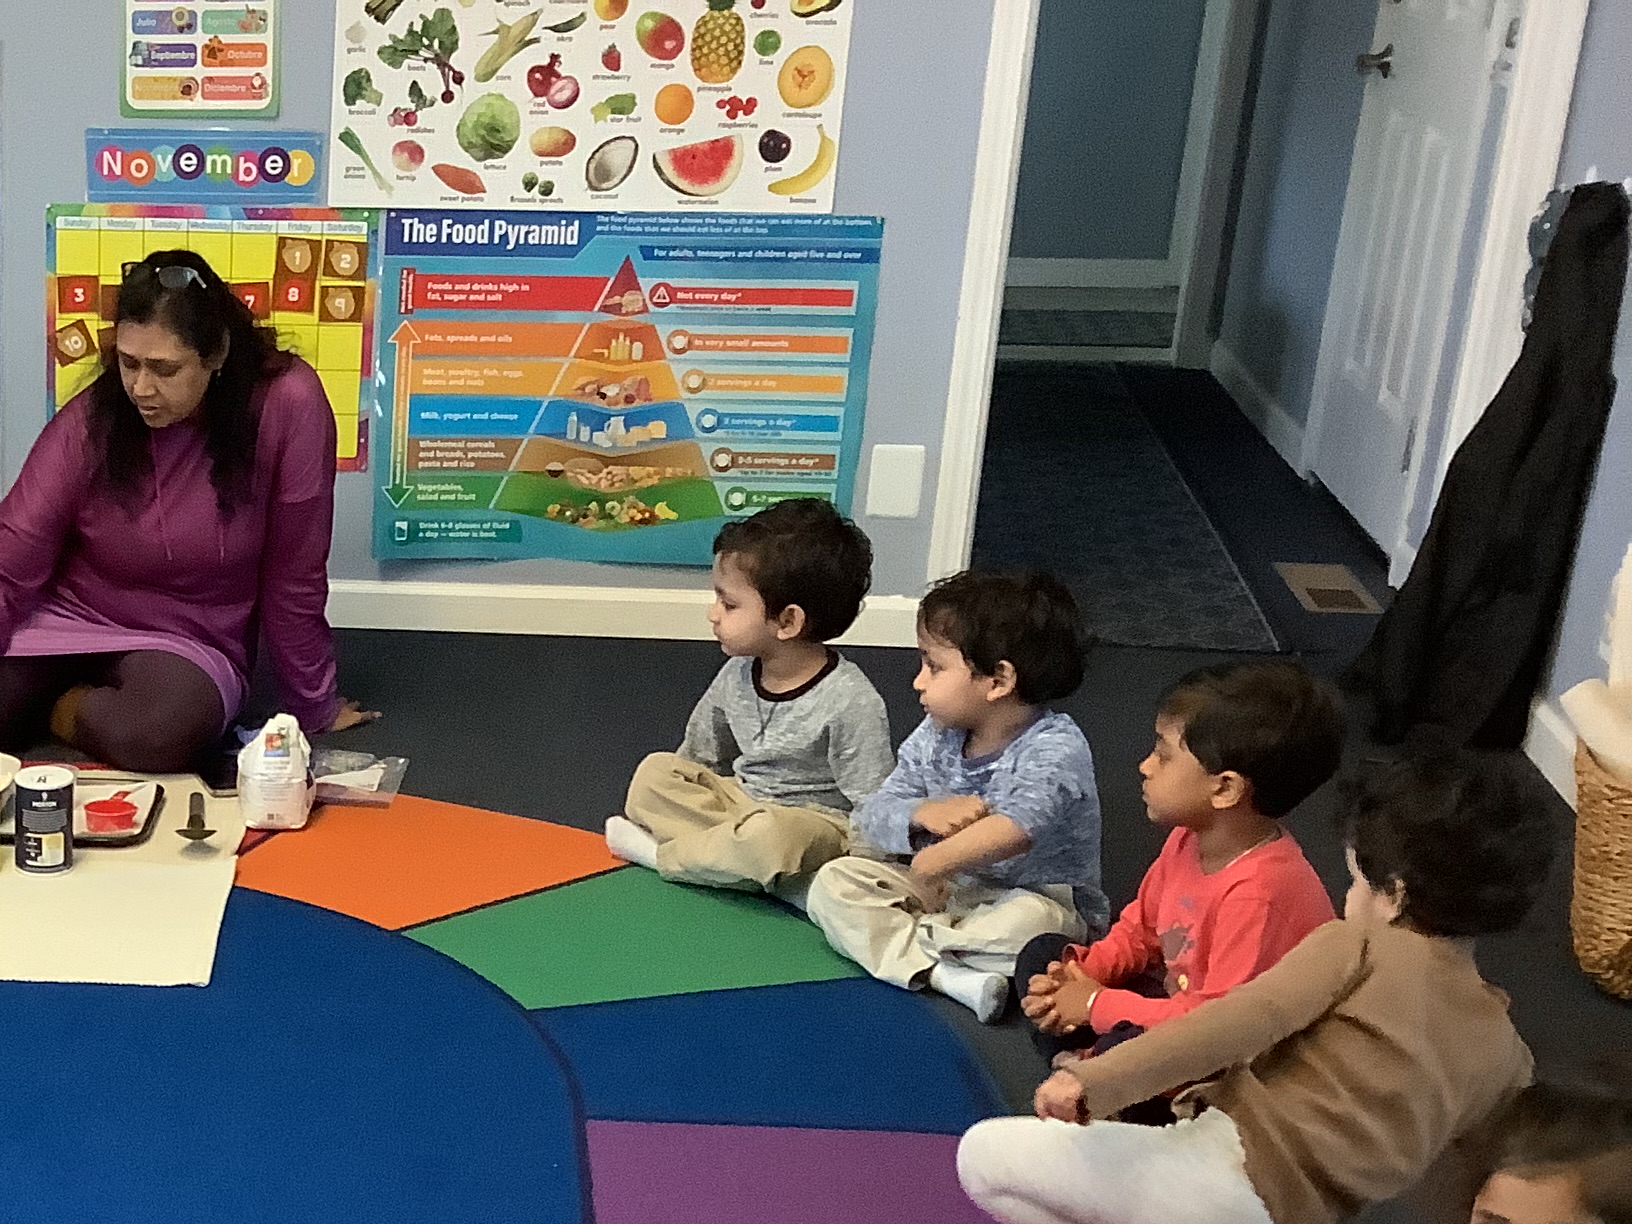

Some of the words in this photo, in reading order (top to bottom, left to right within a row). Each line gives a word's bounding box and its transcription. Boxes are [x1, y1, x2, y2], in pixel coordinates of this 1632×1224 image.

[136, 18, 156, 27] Julio
[151, 51, 195, 61] Septiembre
[227, 51, 263, 60] Octubre
[204, 84, 246, 92] Diciembre
[348, 108, 377, 116] broccoli
[718, 121, 758, 130] raspberries
[101, 149, 304, 180] November
[539, 159, 563, 167] potato
[396, 174, 417, 183] turnip
[63, 219, 92, 230] Sunday
[106, 220, 137, 231] Monday
[150, 220, 181, 231] Tuesday
[189, 221, 231, 232] Wednesday
[236, 222, 273, 233] Thursday
[287, 222, 312, 233] Friday
[327, 223, 364, 234] Saturday
[402, 218, 437, 243] The
[441, 219, 489, 244] Food
[493, 220, 579, 249] Pyramid
[293, 251, 301, 265] 1
[339, 254, 352, 268] 2
[427, 282, 452, 290] Foods
[472, 283, 498, 291] drinks
[500, 283, 519, 292] high
[73, 288, 85, 302] 3
[244, 295, 255, 309] 7
[287, 287, 300, 301] 8
[334, 299, 346, 312] 9
[443, 294, 467, 302] sugar
[487, 293, 502, 301] salt
[695, 293, 719, 301] every
[65, 335, 82, 352] 10
[447, 335, 478, 343] spreads
[705, 340, 724, 348] very
[726, 339, 749, 347] small
[761, 379, 777, 388] day
[443, 412, 470, 421] yogurt
[473, 412, 488, 420] and
[419, 440, 465, 448] Wholemeal
[418, 461, 440, 469] pasta
[754, 457, 789, 466] servings
